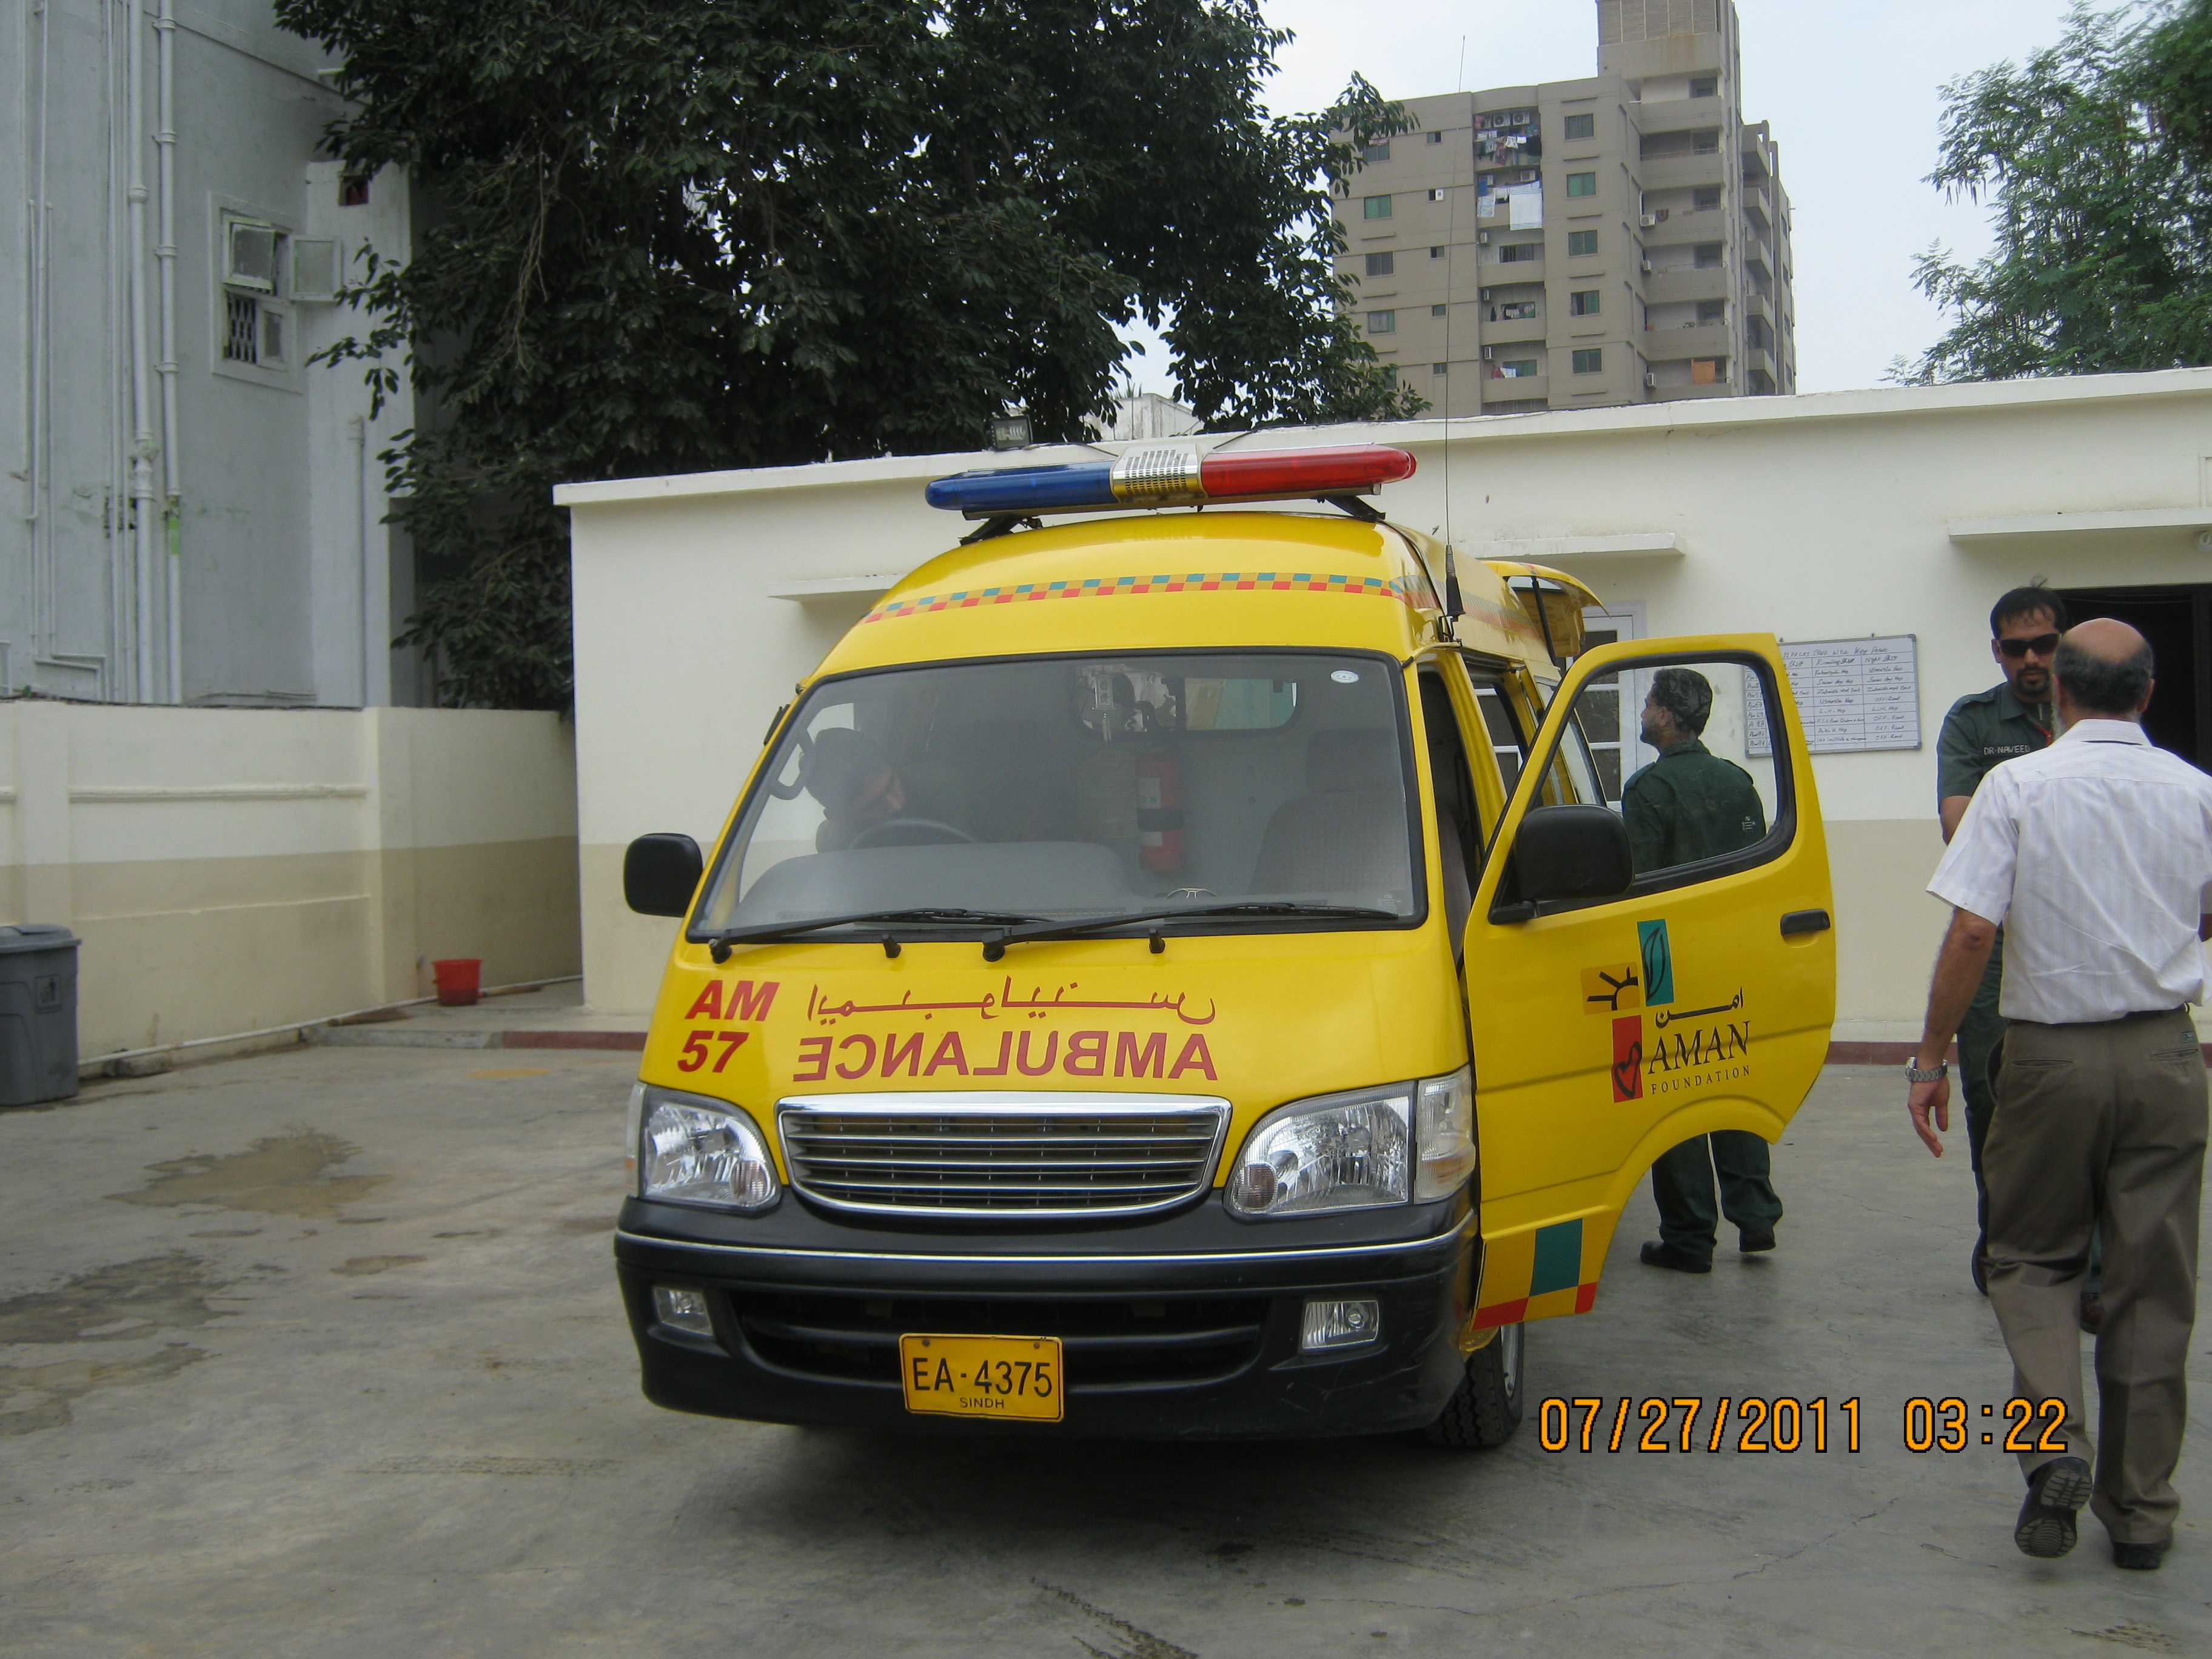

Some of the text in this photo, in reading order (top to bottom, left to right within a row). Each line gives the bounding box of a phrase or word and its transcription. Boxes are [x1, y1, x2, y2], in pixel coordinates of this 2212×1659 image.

[685, 980, 780, 1022] AM
[1655, 987, 1744, 1030] امن
[678, 1030, 749, 1073] 57
[1647, 1021, 1751, 1074] AMAN
[1651, 1065, 1750, 1094] FOUNDATION
[959, 1397, 1005, 1409] SINDH
